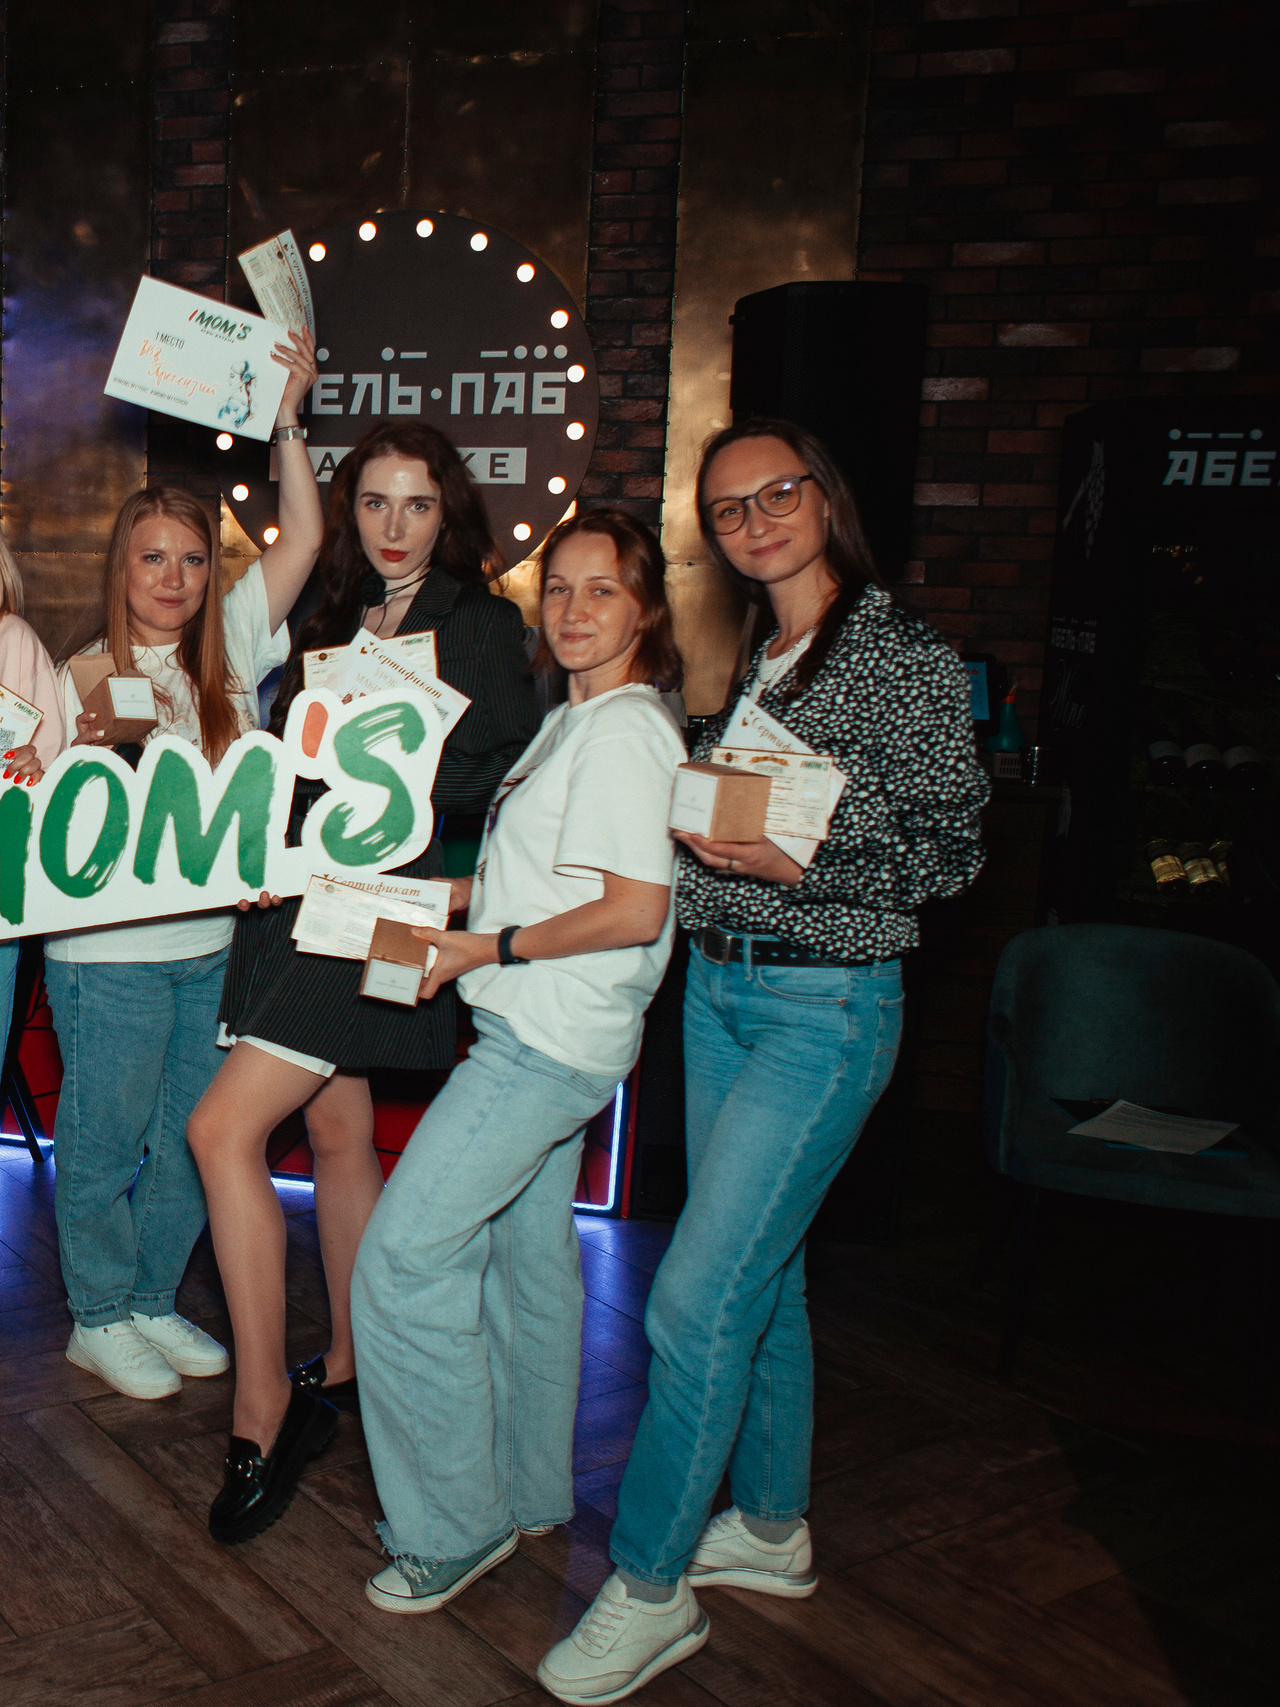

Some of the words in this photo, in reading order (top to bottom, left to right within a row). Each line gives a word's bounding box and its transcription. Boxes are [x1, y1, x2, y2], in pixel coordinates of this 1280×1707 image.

[159, 333, 185, 350] МЕСТО
[1162, 451, 1280, 486] АБЕ
[372, 647, 442, 700] Сертификат
[1049, 658, 1087, 732] Wine
